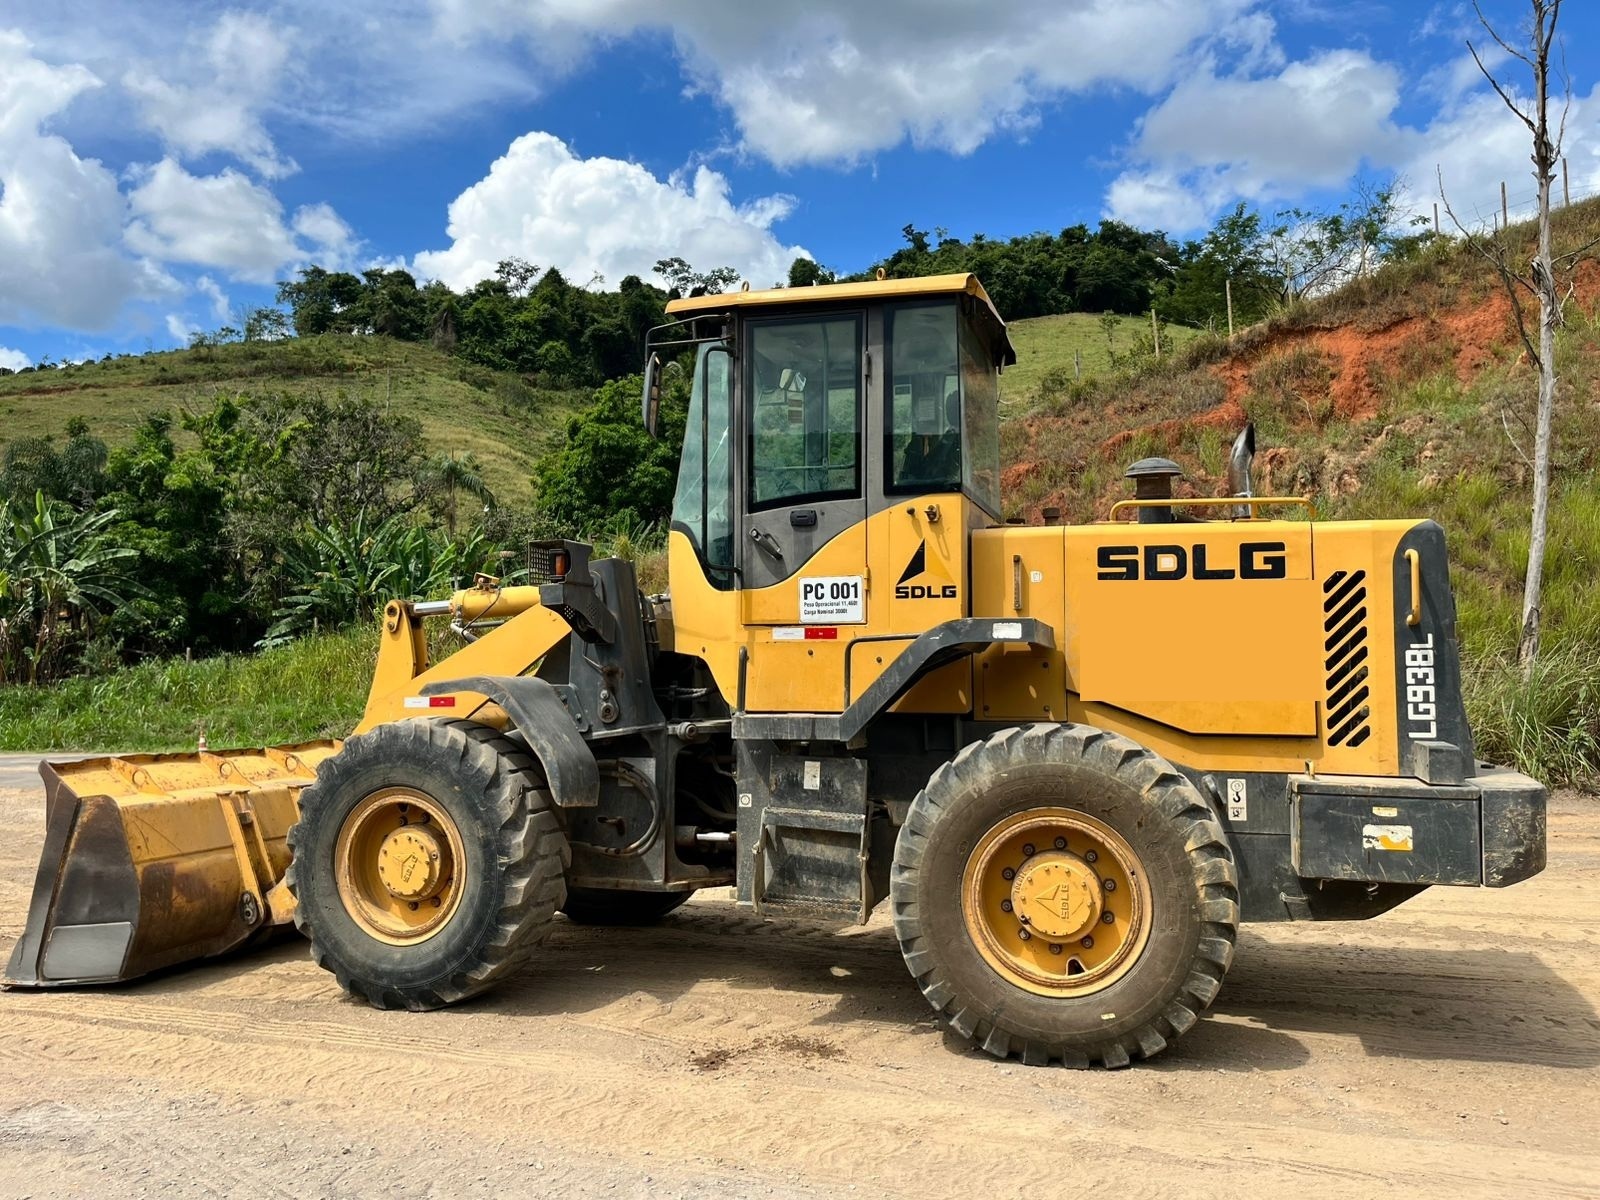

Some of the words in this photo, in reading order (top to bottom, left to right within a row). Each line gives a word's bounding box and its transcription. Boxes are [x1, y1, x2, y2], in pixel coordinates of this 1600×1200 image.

[1097, 542, 1286, 580] SDLG
[803, 583, 825, 600] PC
[830, 582, 858, 600] 001
[895, 585, 957, 599] SDLG
[1405, 633, 1437, 739] LG938L
